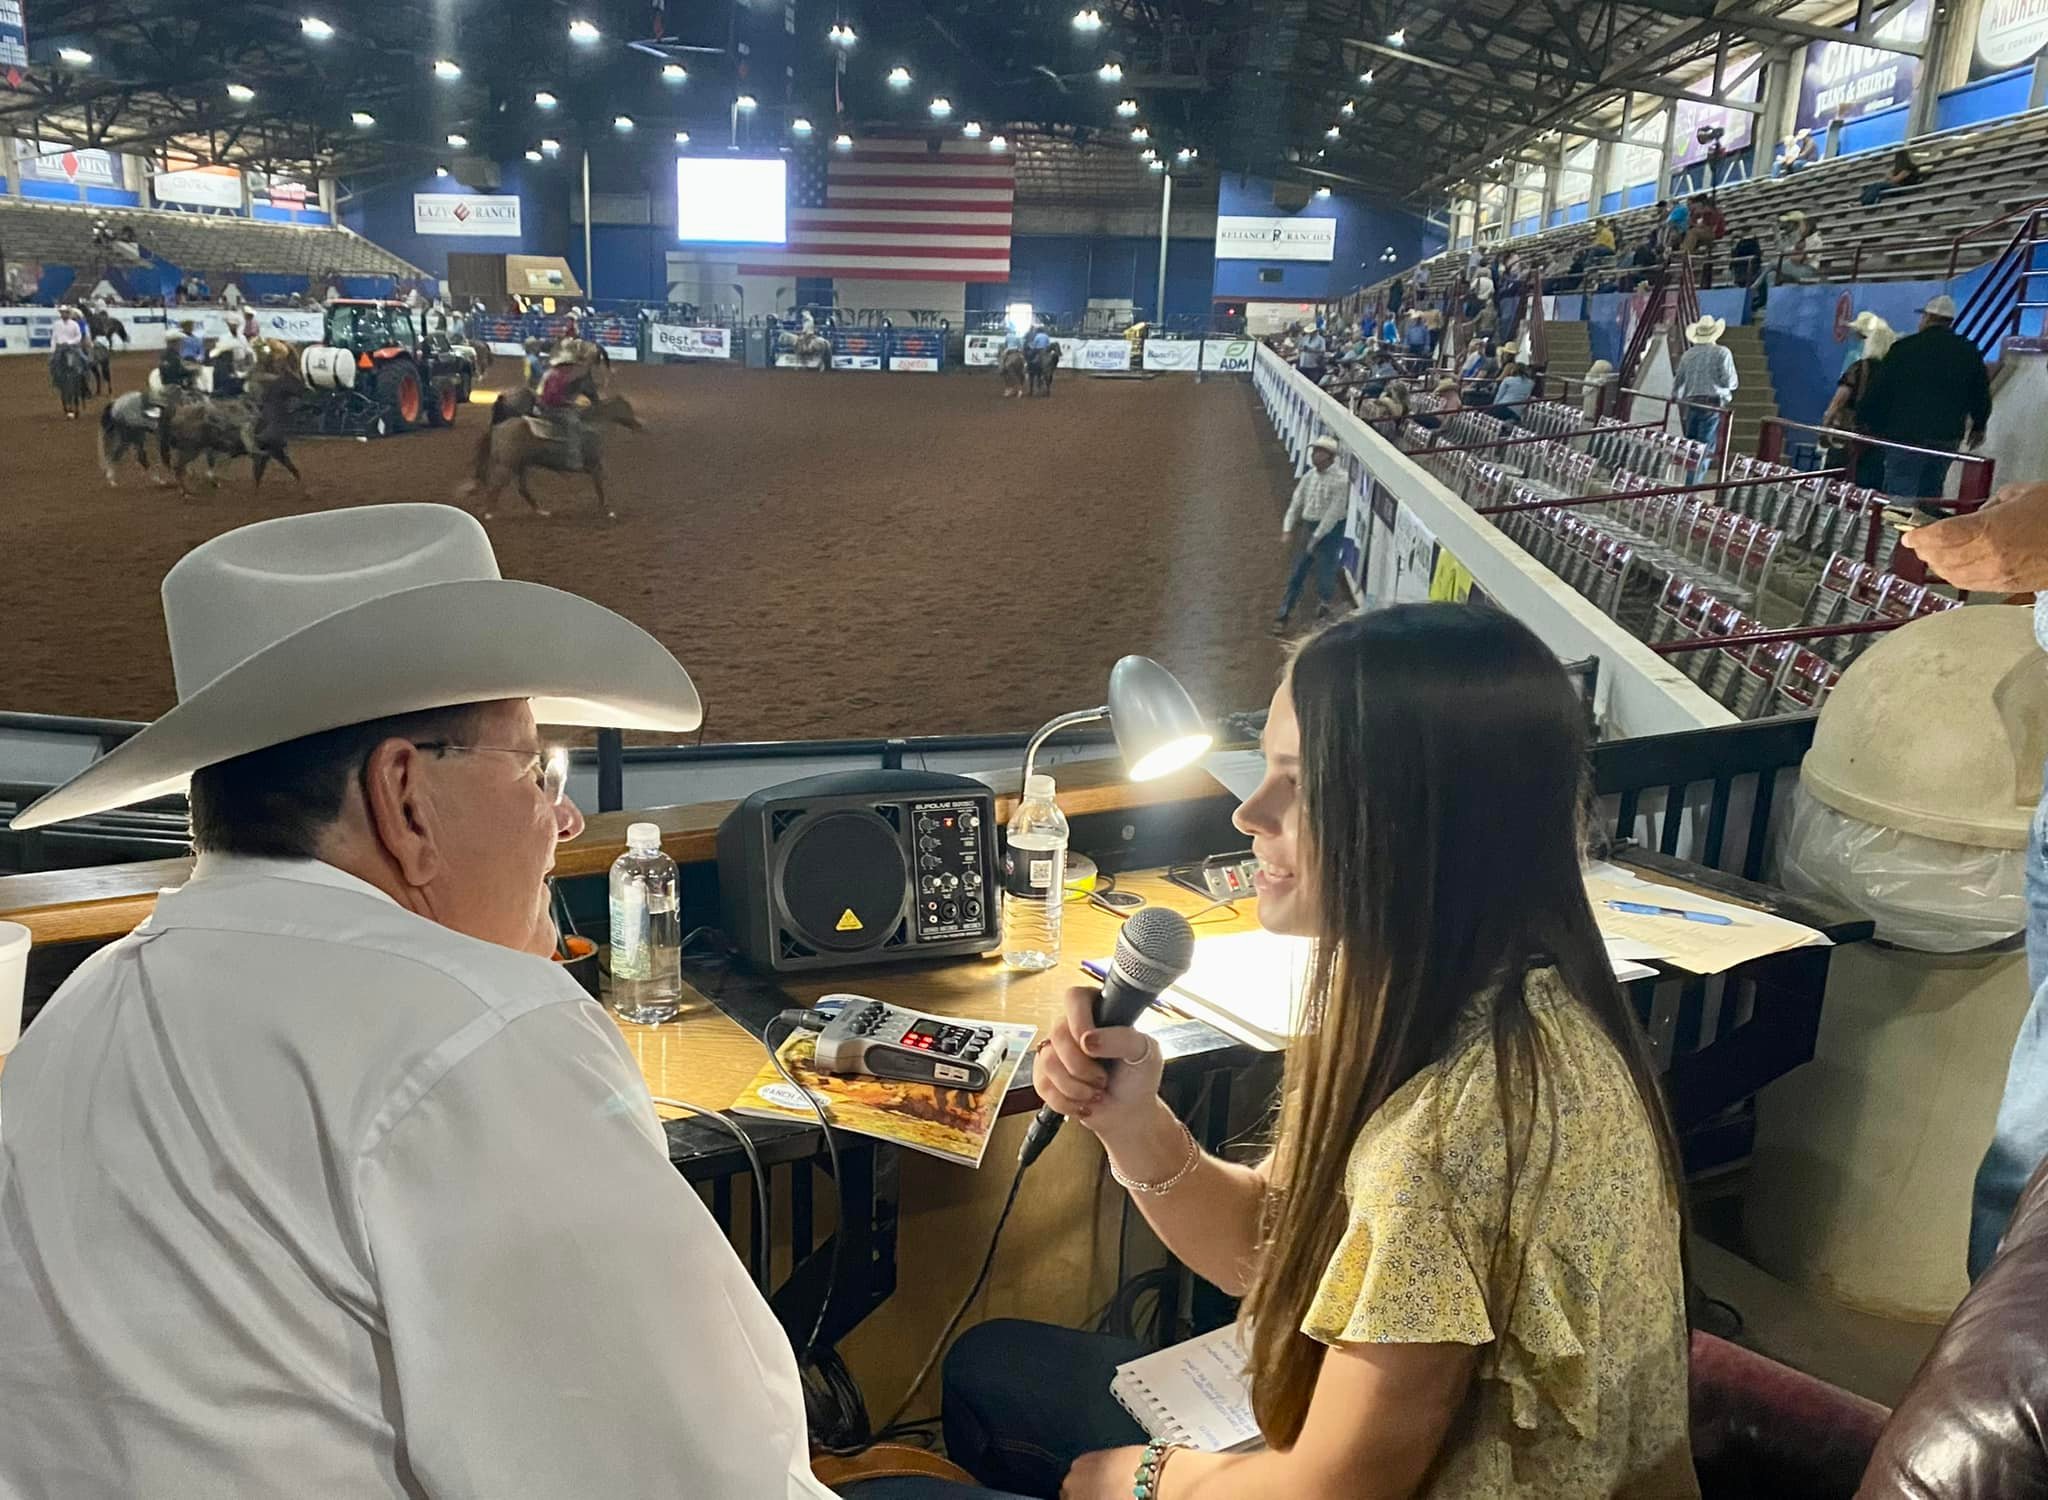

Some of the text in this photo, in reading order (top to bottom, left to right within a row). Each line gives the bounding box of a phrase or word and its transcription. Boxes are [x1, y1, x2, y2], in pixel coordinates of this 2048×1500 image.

[1813, 84, 1846, 118] JEANS
[1846, 80, 1856, 104] &
[1855, 65, 1898, 99] SHIRTS
[418, 205, 449, 218] LAZY
[475, 206, 517, 219] RANCH
[1221, 231, 1266, 241] RELIANCE
[1286, 232, 1332, 241] RANCHES
[659, 331, 689, 345] Best
[1220, 358, 1249, 370] ADM
[914, 802, 951, 810] EUROLIVE
